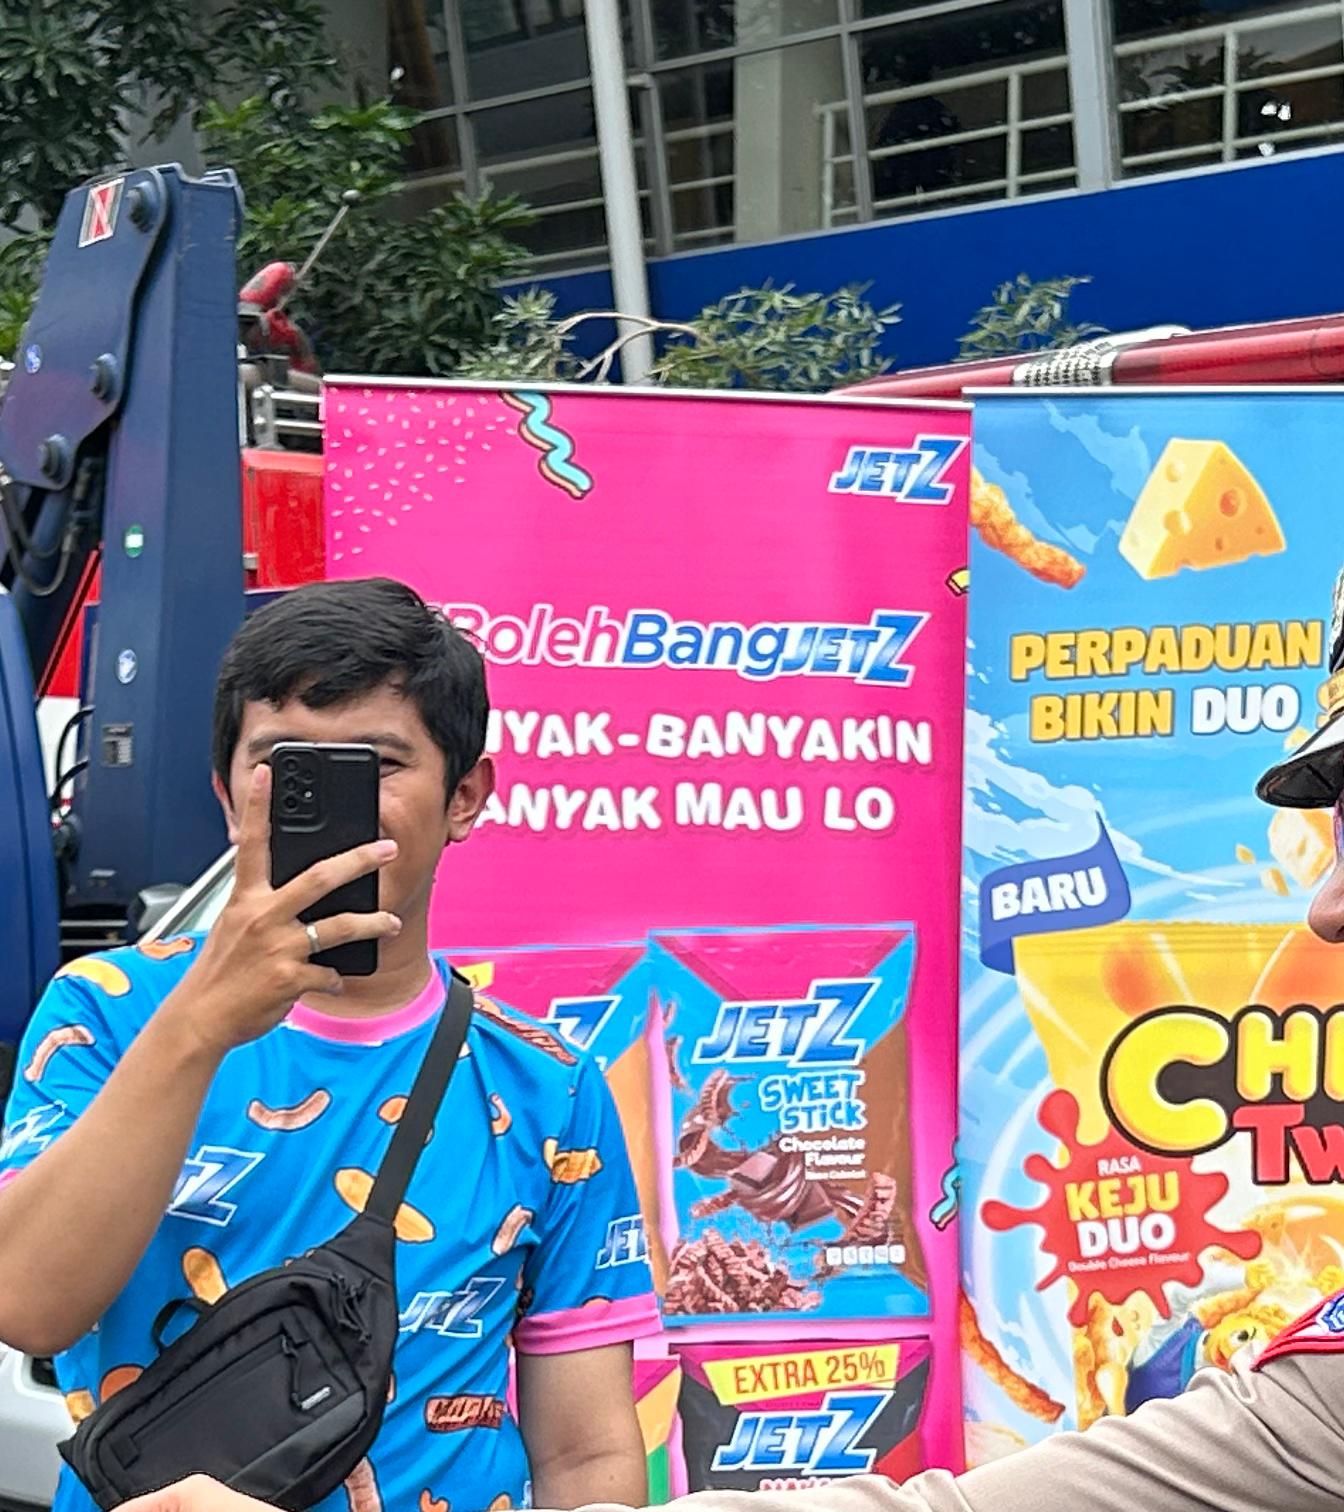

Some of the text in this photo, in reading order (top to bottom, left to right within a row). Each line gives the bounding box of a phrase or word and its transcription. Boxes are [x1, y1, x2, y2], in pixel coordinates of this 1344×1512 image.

[828, 434, 970, 504] JETZ
[444, 604, 928, 686] BolehBangJETZ
[1010, 620, 1324, 681] PERPADUAN
[1029, 688, 1174, 742] BIKIN
[1191, 683, 1299, 735] DUO
[674, 782, 804, 832] MAU
[823, 786, 894, 831] LO
[990, 866, 1108, 921] BARU
[691, 978, 882, 1068] JETZ
[759, 1070, 865, 1111] SWEET
[779, 1136, 866, 1152] Chocolate
[805, 1152, 866, 1166] Flavour
[1097, 1155, 1142, 1177] RASA
[1064, 1170, 1180, 1222] KEJU
[1076, 1212, 1176, 1257] DUO
[734, 1350, 886, 1394] EXTRA 25%
[711, 1390, 895, 1476] JETZ
